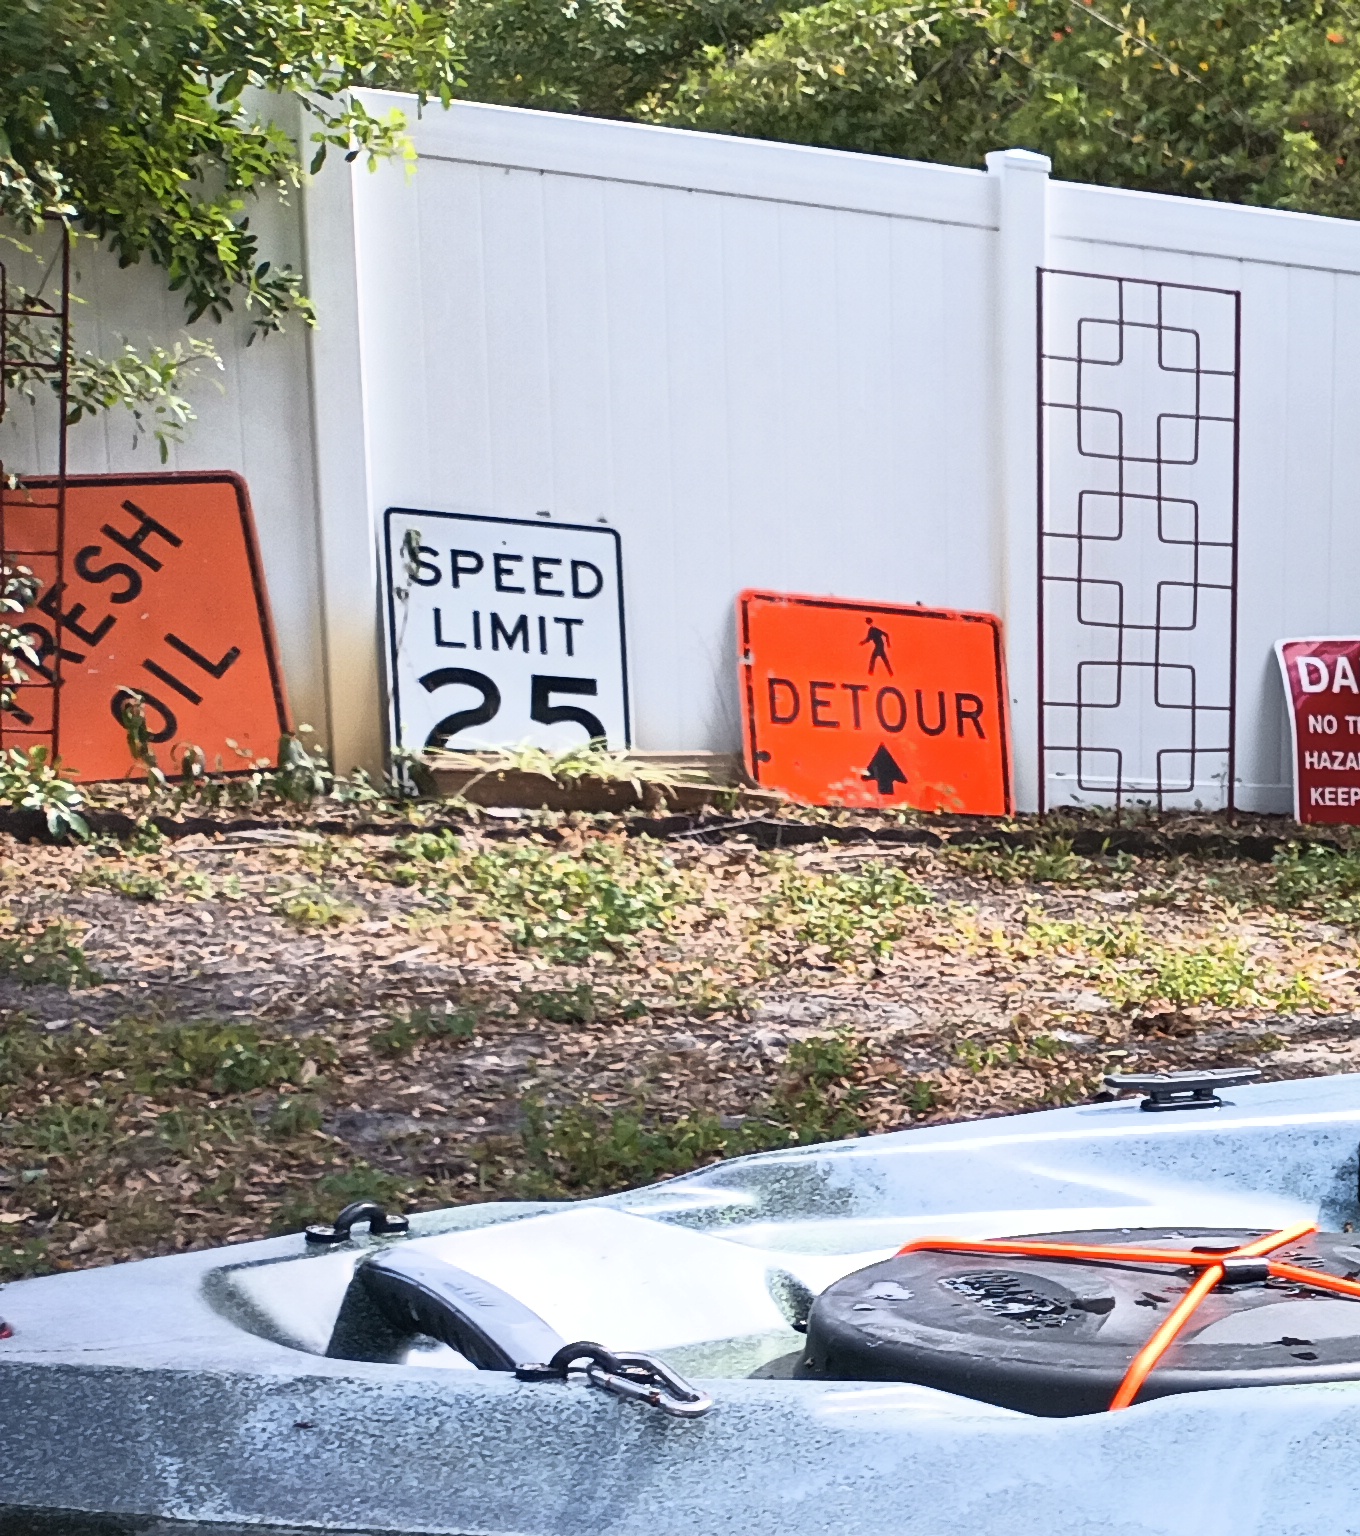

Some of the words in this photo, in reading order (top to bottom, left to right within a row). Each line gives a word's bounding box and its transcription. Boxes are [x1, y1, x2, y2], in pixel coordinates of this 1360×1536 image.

[409, 545, 604, 600] SPEED
[2, 499, 183, 725] RESH
[432, 606, 584, 657] LIMIT
[110, 632, 241, 743] OIL
[418, 667, 608, 755] 25
[767, 676, 986, 740] DETOUR
[1308, 713, 1338, 735] NO
